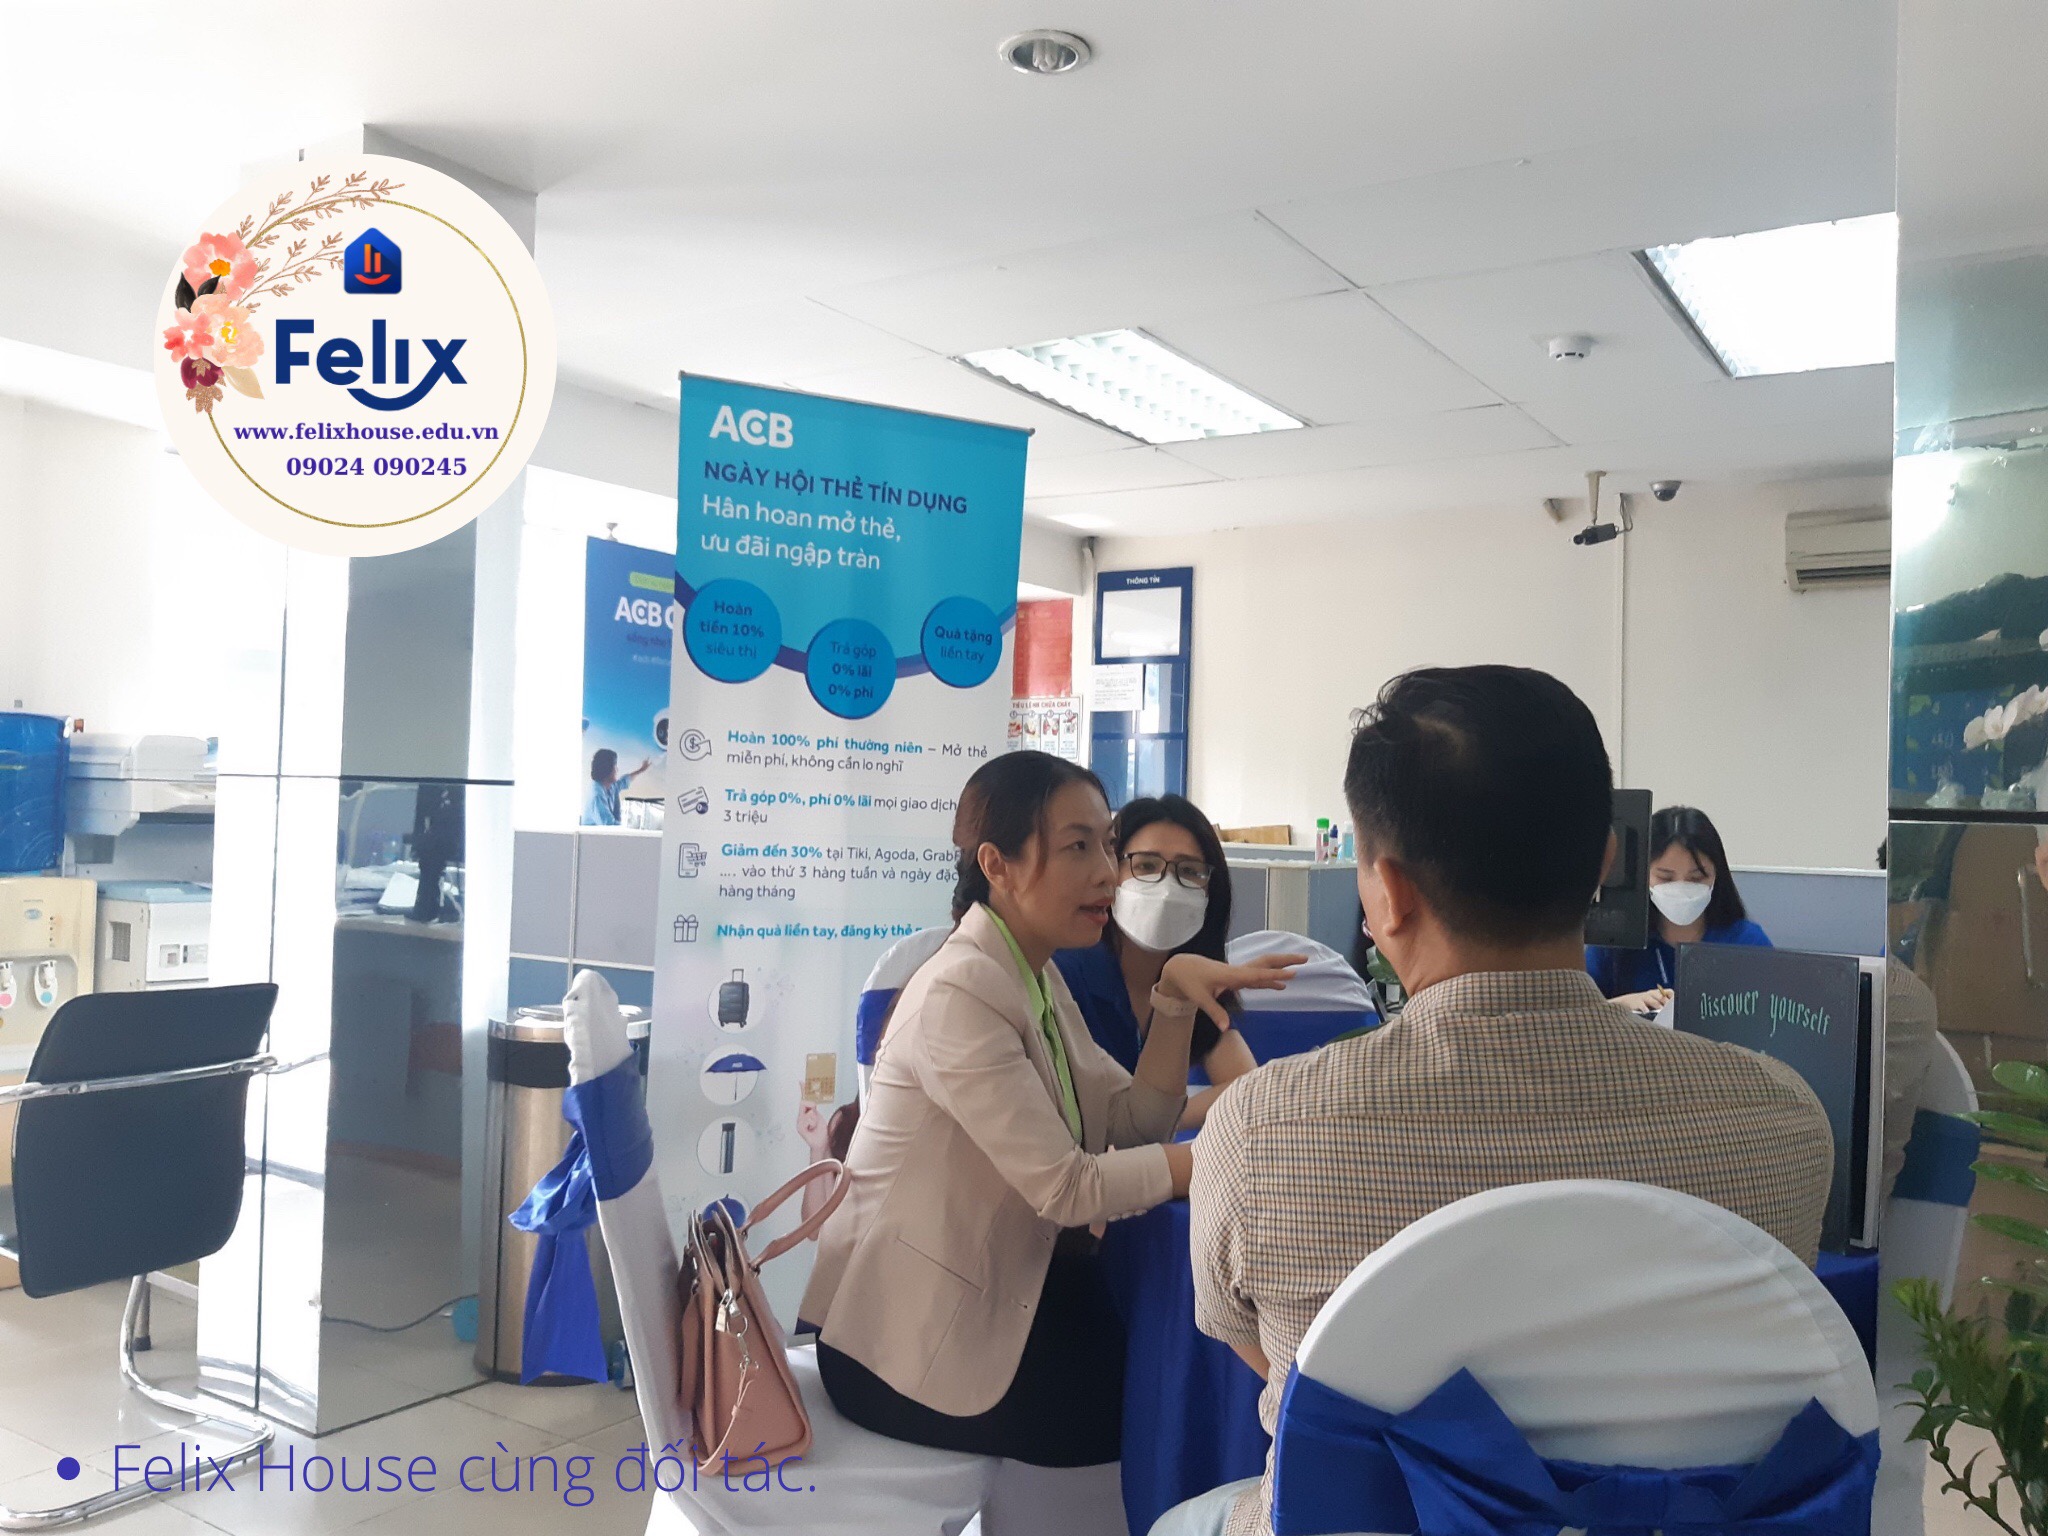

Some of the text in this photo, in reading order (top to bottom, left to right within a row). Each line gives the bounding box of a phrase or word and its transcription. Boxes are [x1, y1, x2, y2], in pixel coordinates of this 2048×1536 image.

[709, 405, 794, 448] ACB
[704, 460, 968, 516] NGÀY HỘI THẺ TÍN DỤNG
[702, 494, 902, 542] Hân hoan mở thẻ,
[701, 534, 881, 570] ưu đãi ngập tràn
[614, 596, 662, 627] ACB
[733, 624, 764, 639] 10%
[832, 662, 855, 676] 0%
[828, 683, 850, 698] 0%
[727, 730, 766, 744] Hoàn
[771, 733, 811, 748] 100%
[816, 736, 839, 750] phí
[844, 738, 890, 755] thường
[942, 743, 962, 757] Mở
[968, 746, 988, 758] thẻ
[726, 750, 762, 765] miễn
[764, 754, 788, 768] phí,
[791, 757, 835, 772] không
[862, 762, 874, 771] lo
[876, 759, 904, 775] nghĩ
[725, 788, 957, 813] Trả góp 0%, phí 0% lãi mọi giao dịch
[723, 809, 768, 826] 3 triệu
[721, 842, 759, 858] Giảm
[762, 842, 788, 858] đến
[790, 845, 823, 859] 30%
[826, 848, 844, 862] tại
[847, 846, 872, 861] Tiki,
[874, 848, 919, 863] Agoda,
[742, 864, 766, 877] vào
[771, 864, 795, 878] thứ
[799, 865, 807, 878] 3
[812, 865, 846, 882] hàng
[881, 866, 896, 879] và
[900, 868, 932, 883] ngày
[719, 884, 796, 901] hàng tháng
[717, 924, 754, 939] Nhận
[757, 924, 781, 939] quà
[813, 926, 838, 940] tay,
[840, 924, 871, 939] đăng
[873, 923, 888, 938] ký
[1769, 992, 1831, 1038] yourself
